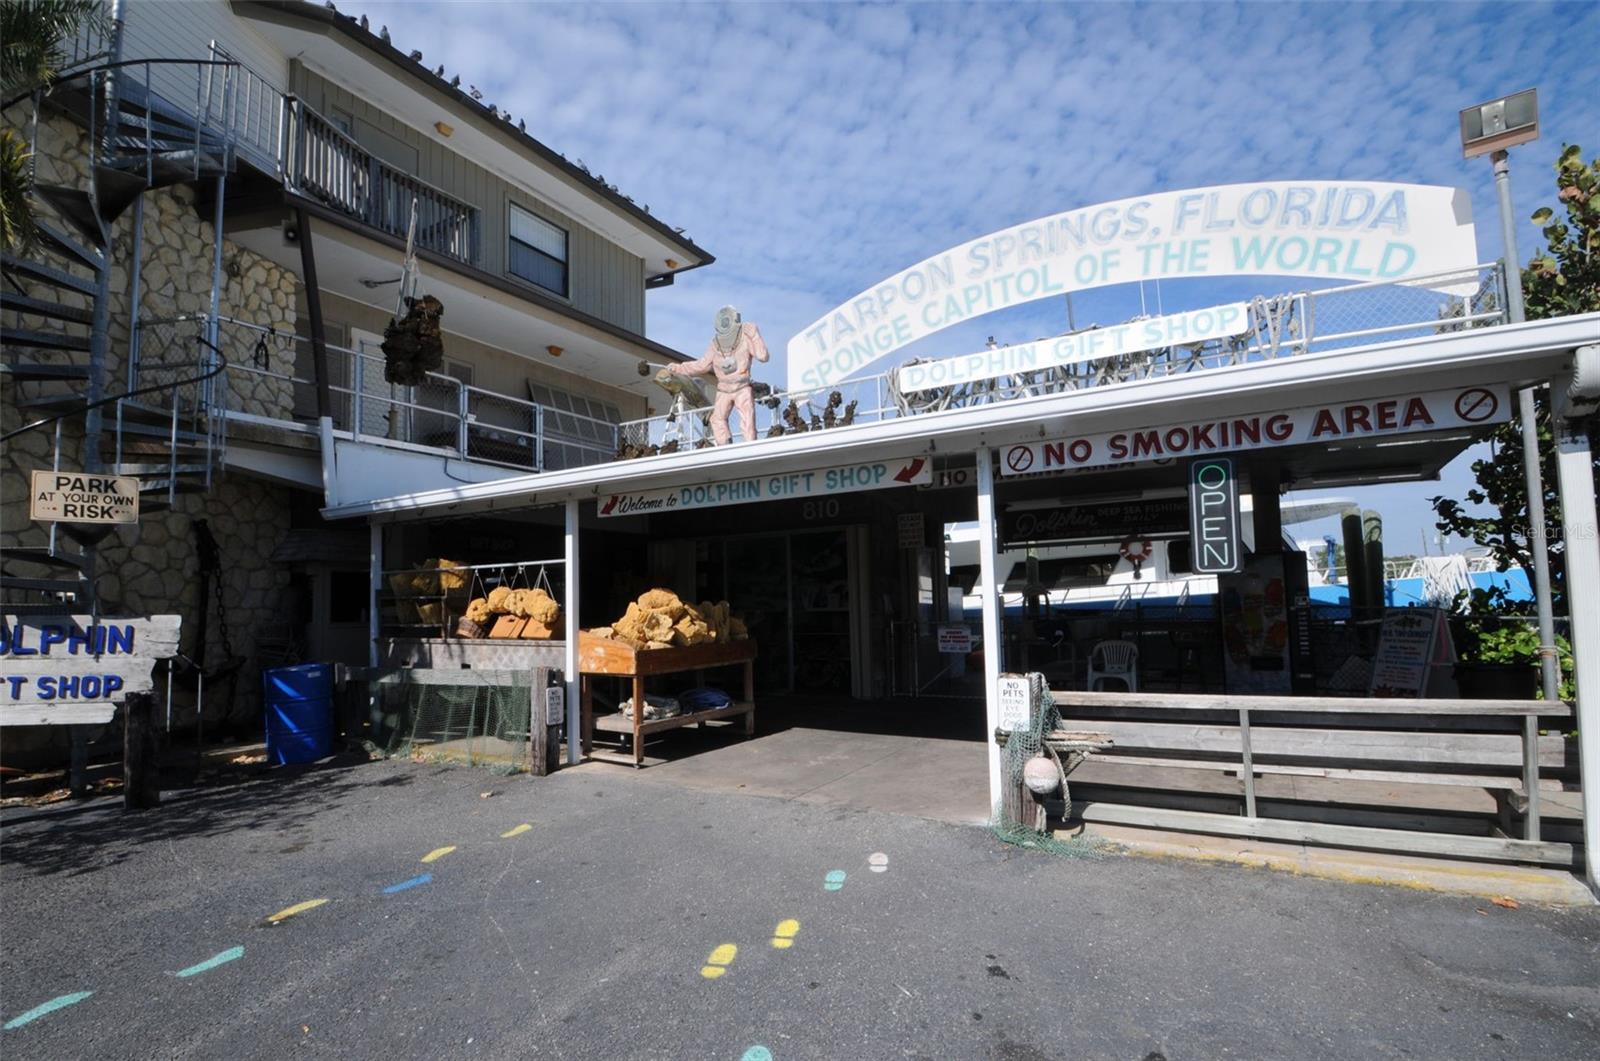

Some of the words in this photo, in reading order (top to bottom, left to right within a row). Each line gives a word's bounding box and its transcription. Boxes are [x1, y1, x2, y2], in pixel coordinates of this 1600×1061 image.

[805, 254, 955, 352] TARPON
[967, 200, 1161, 278] SPRINGS,
[1171, 186, 1410, 236] FLORIDA
[801, 314, 914, 391] SPONGE
[920, 263, 1064, 328] CAPITOL
[1074, 248, 1121, 285] OF
[1135, 239, 1210, 277] THE
[1231, 235, 1418, 278] WORLD
[906, 344, 1038, 388] DOLPHIN
[1052, 326, 1131, 362] GIFT
[1143, 306, 1241, 347] SHOP
[1043, 439, 1092, 466] NO
[1109, 414, 1294, 459] SMOKING
[1311, 397, 1434, 437] AREA
[38, 491, 56, 502] AT
[62, 493, 98, 504] YOUR
[103, 495, 134, 507] OWN
[56, 476, 118, 494] PARK
[618, 495, 663, 514] Welcome
[665, 494, 678, 507] to
[680, 479, 761, 506] DOLPHIN
[769, 473, 815, 497] GIFT
[826, 464, 887, 490] SHOP
[63, 504, 114, 519] RISK
[802, 498, 840, 520] 810
[1012, 505, 1098, 540] Dolphin
[1123, 505, 1142, 516] SEA
[1199, 465, 1228, 567] OPEN
[0, 625, 135, 655] LPHIN
[37, 675, 124, 700] SHOP
[1003, 689, 1024, 697] PETS
